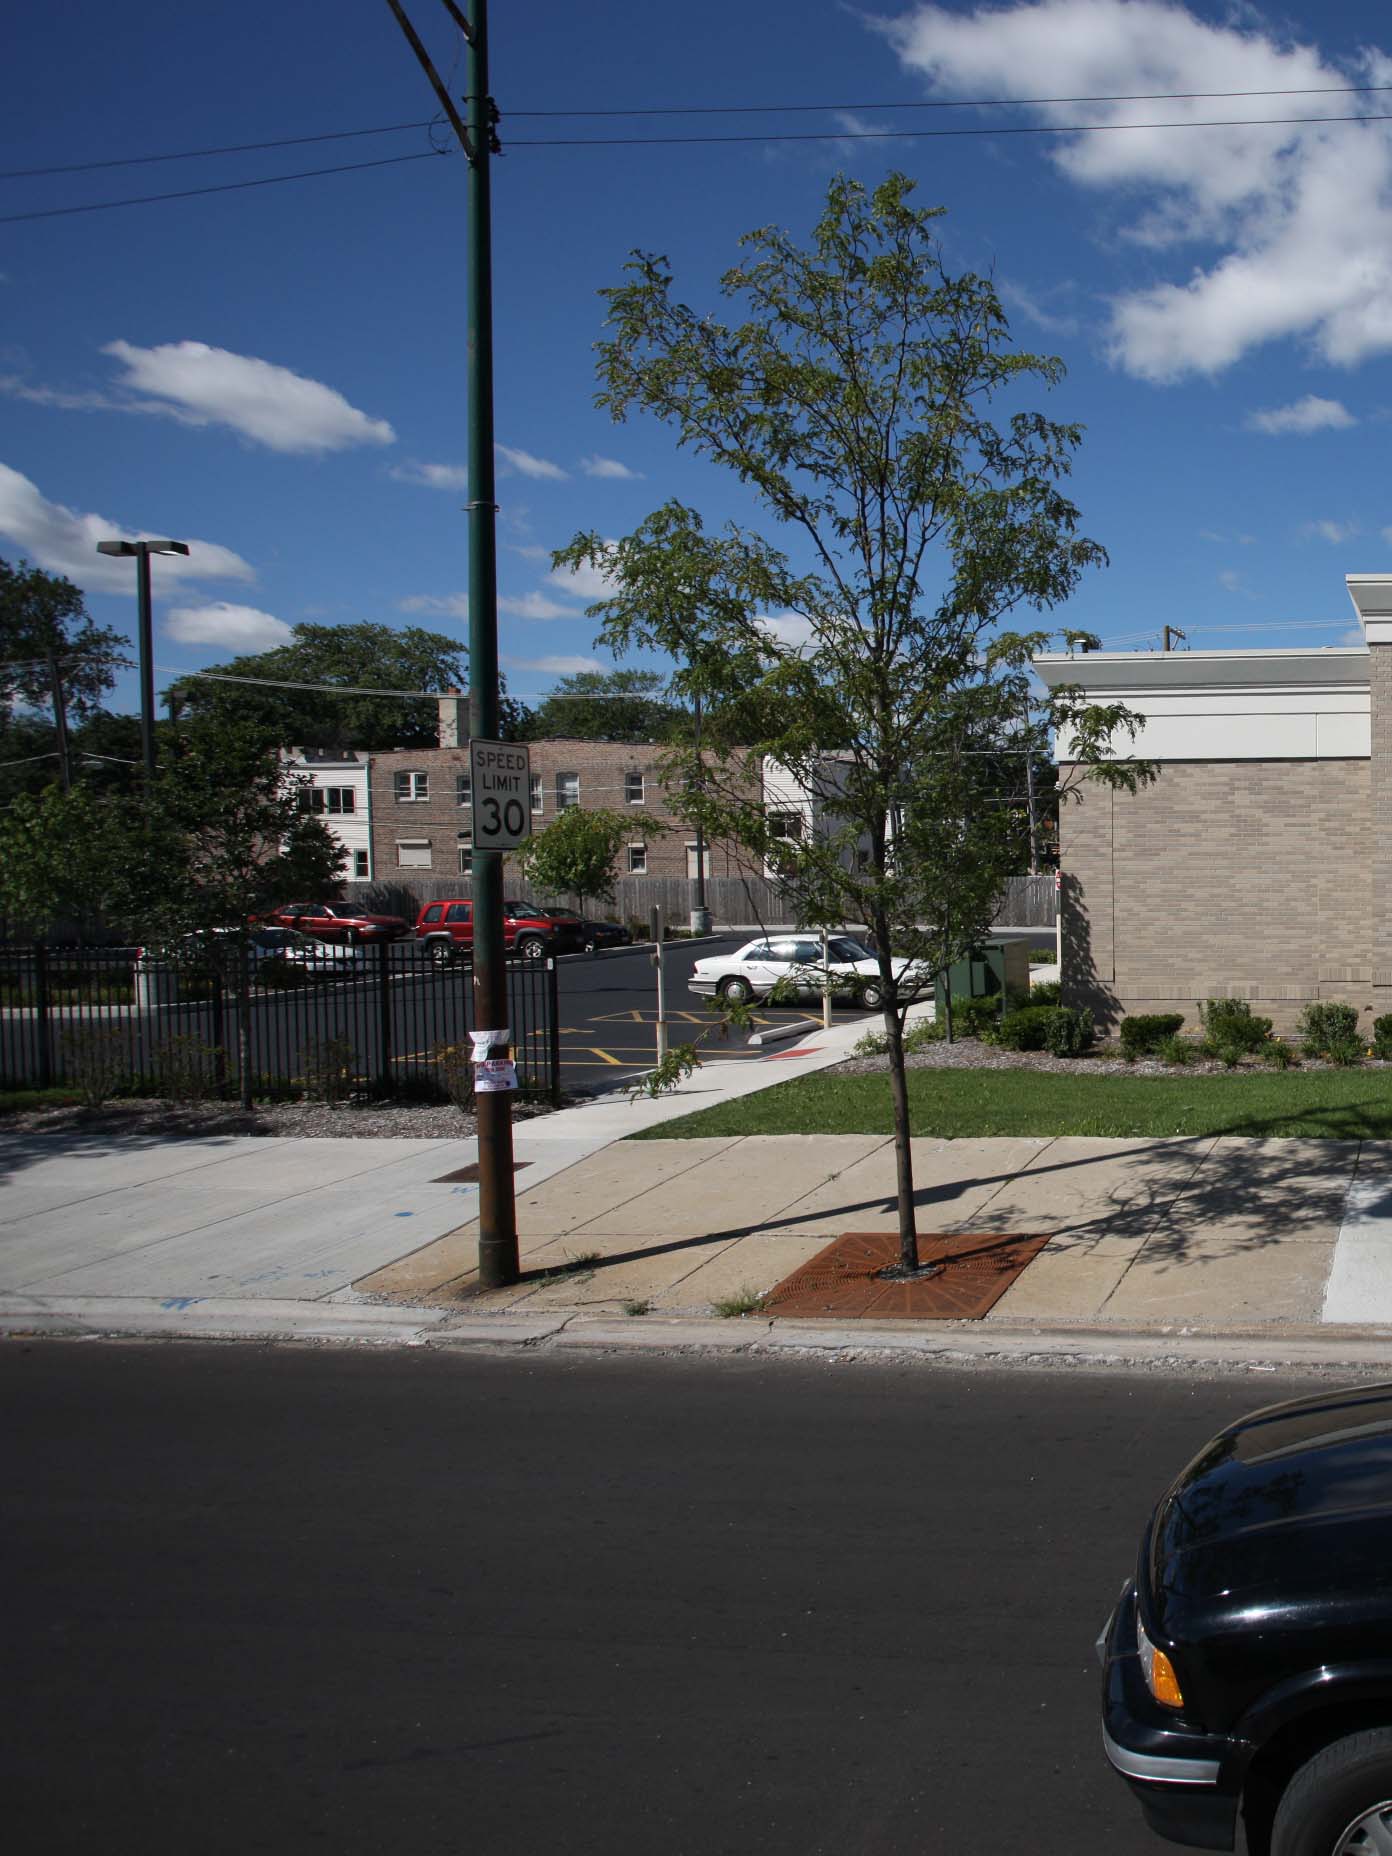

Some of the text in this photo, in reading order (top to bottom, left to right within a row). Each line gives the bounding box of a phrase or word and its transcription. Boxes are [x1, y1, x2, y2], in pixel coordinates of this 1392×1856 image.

[476, 751, 526, 770] SPEED
[482, 773, 521, 792] LIMIT
[481, 797, 525, 837] 30
